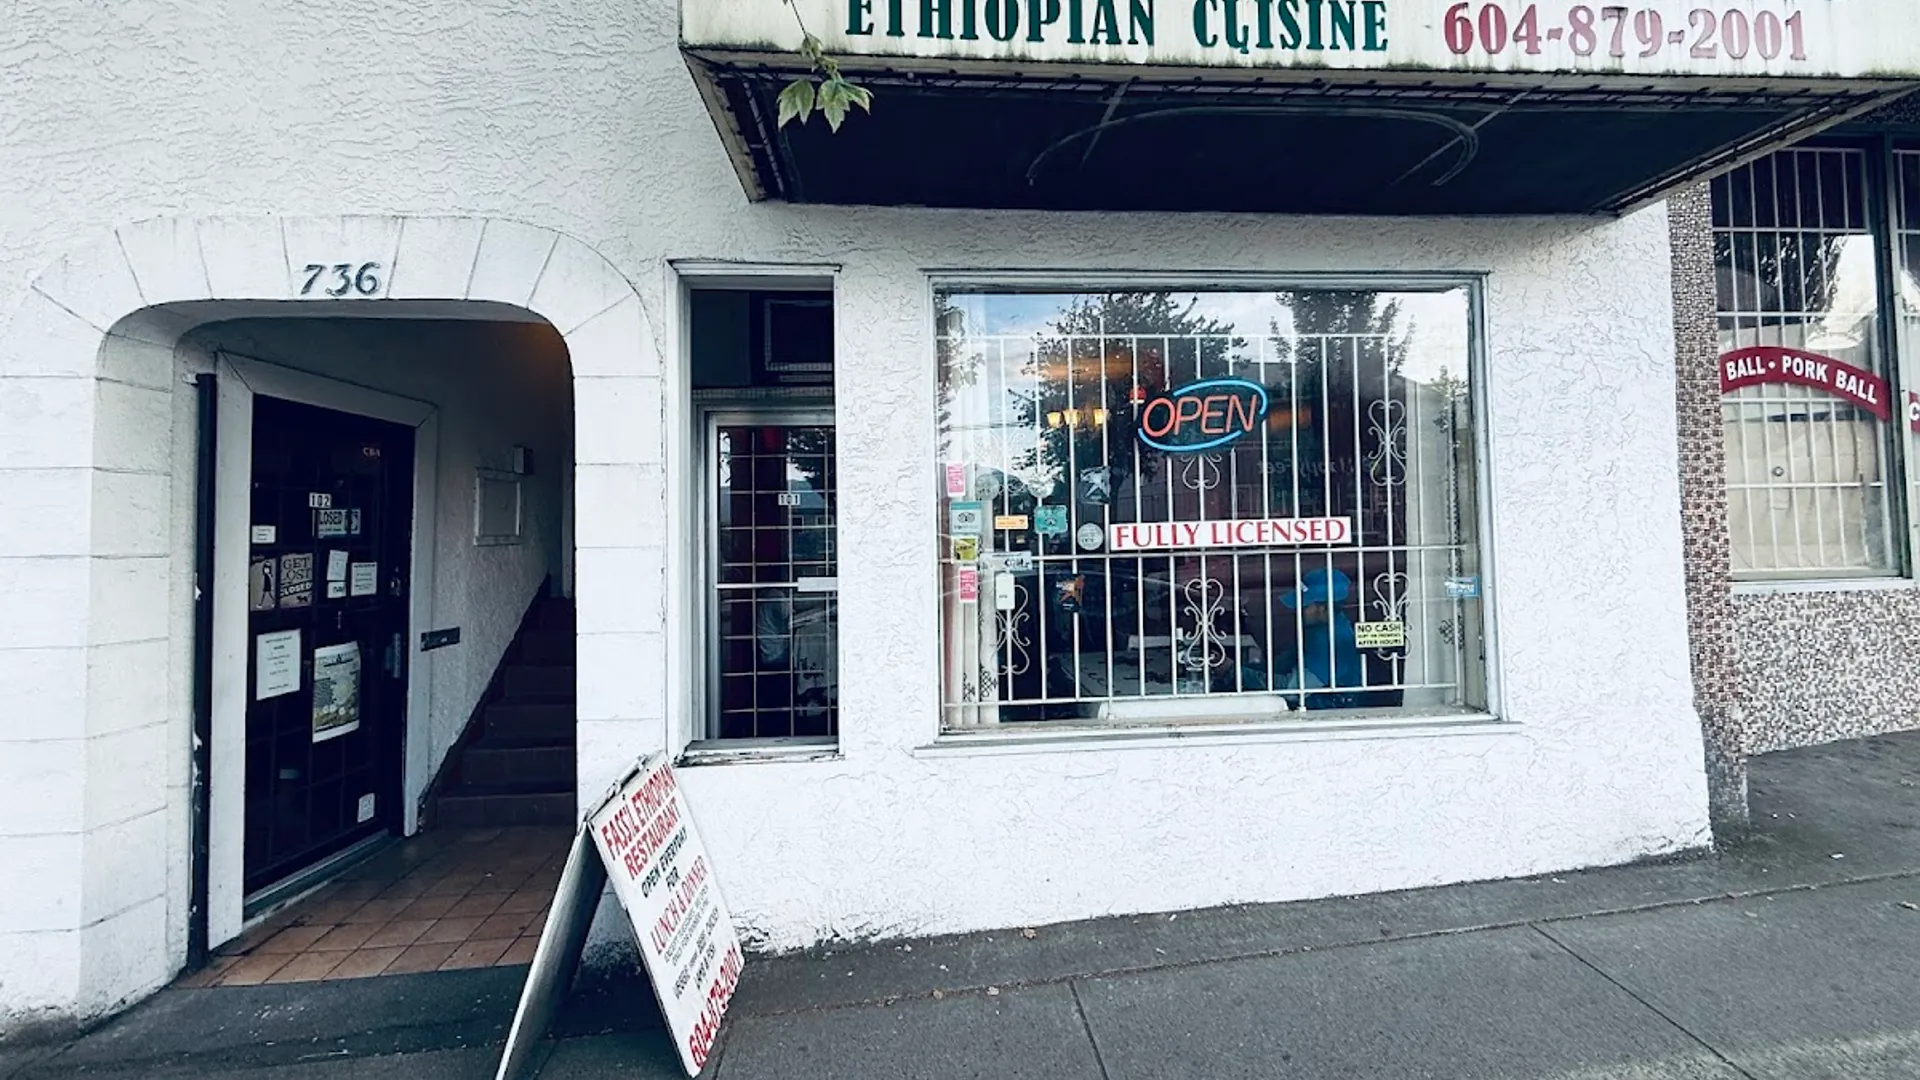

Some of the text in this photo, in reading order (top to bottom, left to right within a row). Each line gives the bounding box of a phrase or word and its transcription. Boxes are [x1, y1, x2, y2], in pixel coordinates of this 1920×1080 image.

[845, 0, 1388, 54] ETHIOPIAN CUISINE
[1443, 2, 1807, 61] 604-879-2001
[300, 261, 381, 297] 736
[1726, 355, 1878, 404] BALL PORK BALL
[1142, 394, 1257, 437] OPEN
[312, 494, 330, 508] 102
[781, 495, 799, 505] 101
[1116, 523, 1200, 548] FULLY
[1211, 519, 1345, 545] LICENSED
[283, 557, 308, 569] GET
[1357, 623, 1401, 633] NO CASH
[601, 761, 676, 862] FASSIL ETHIOPIAN
[624, 796, 681, 881] RESTAURANT
[641, 824, 688, 898] OPEN EVERYDAY
[665, 866, 681, 892] FOR
[650, 898, 681, 956] LUNCH
[681, 855, 708, 905] DINNER
